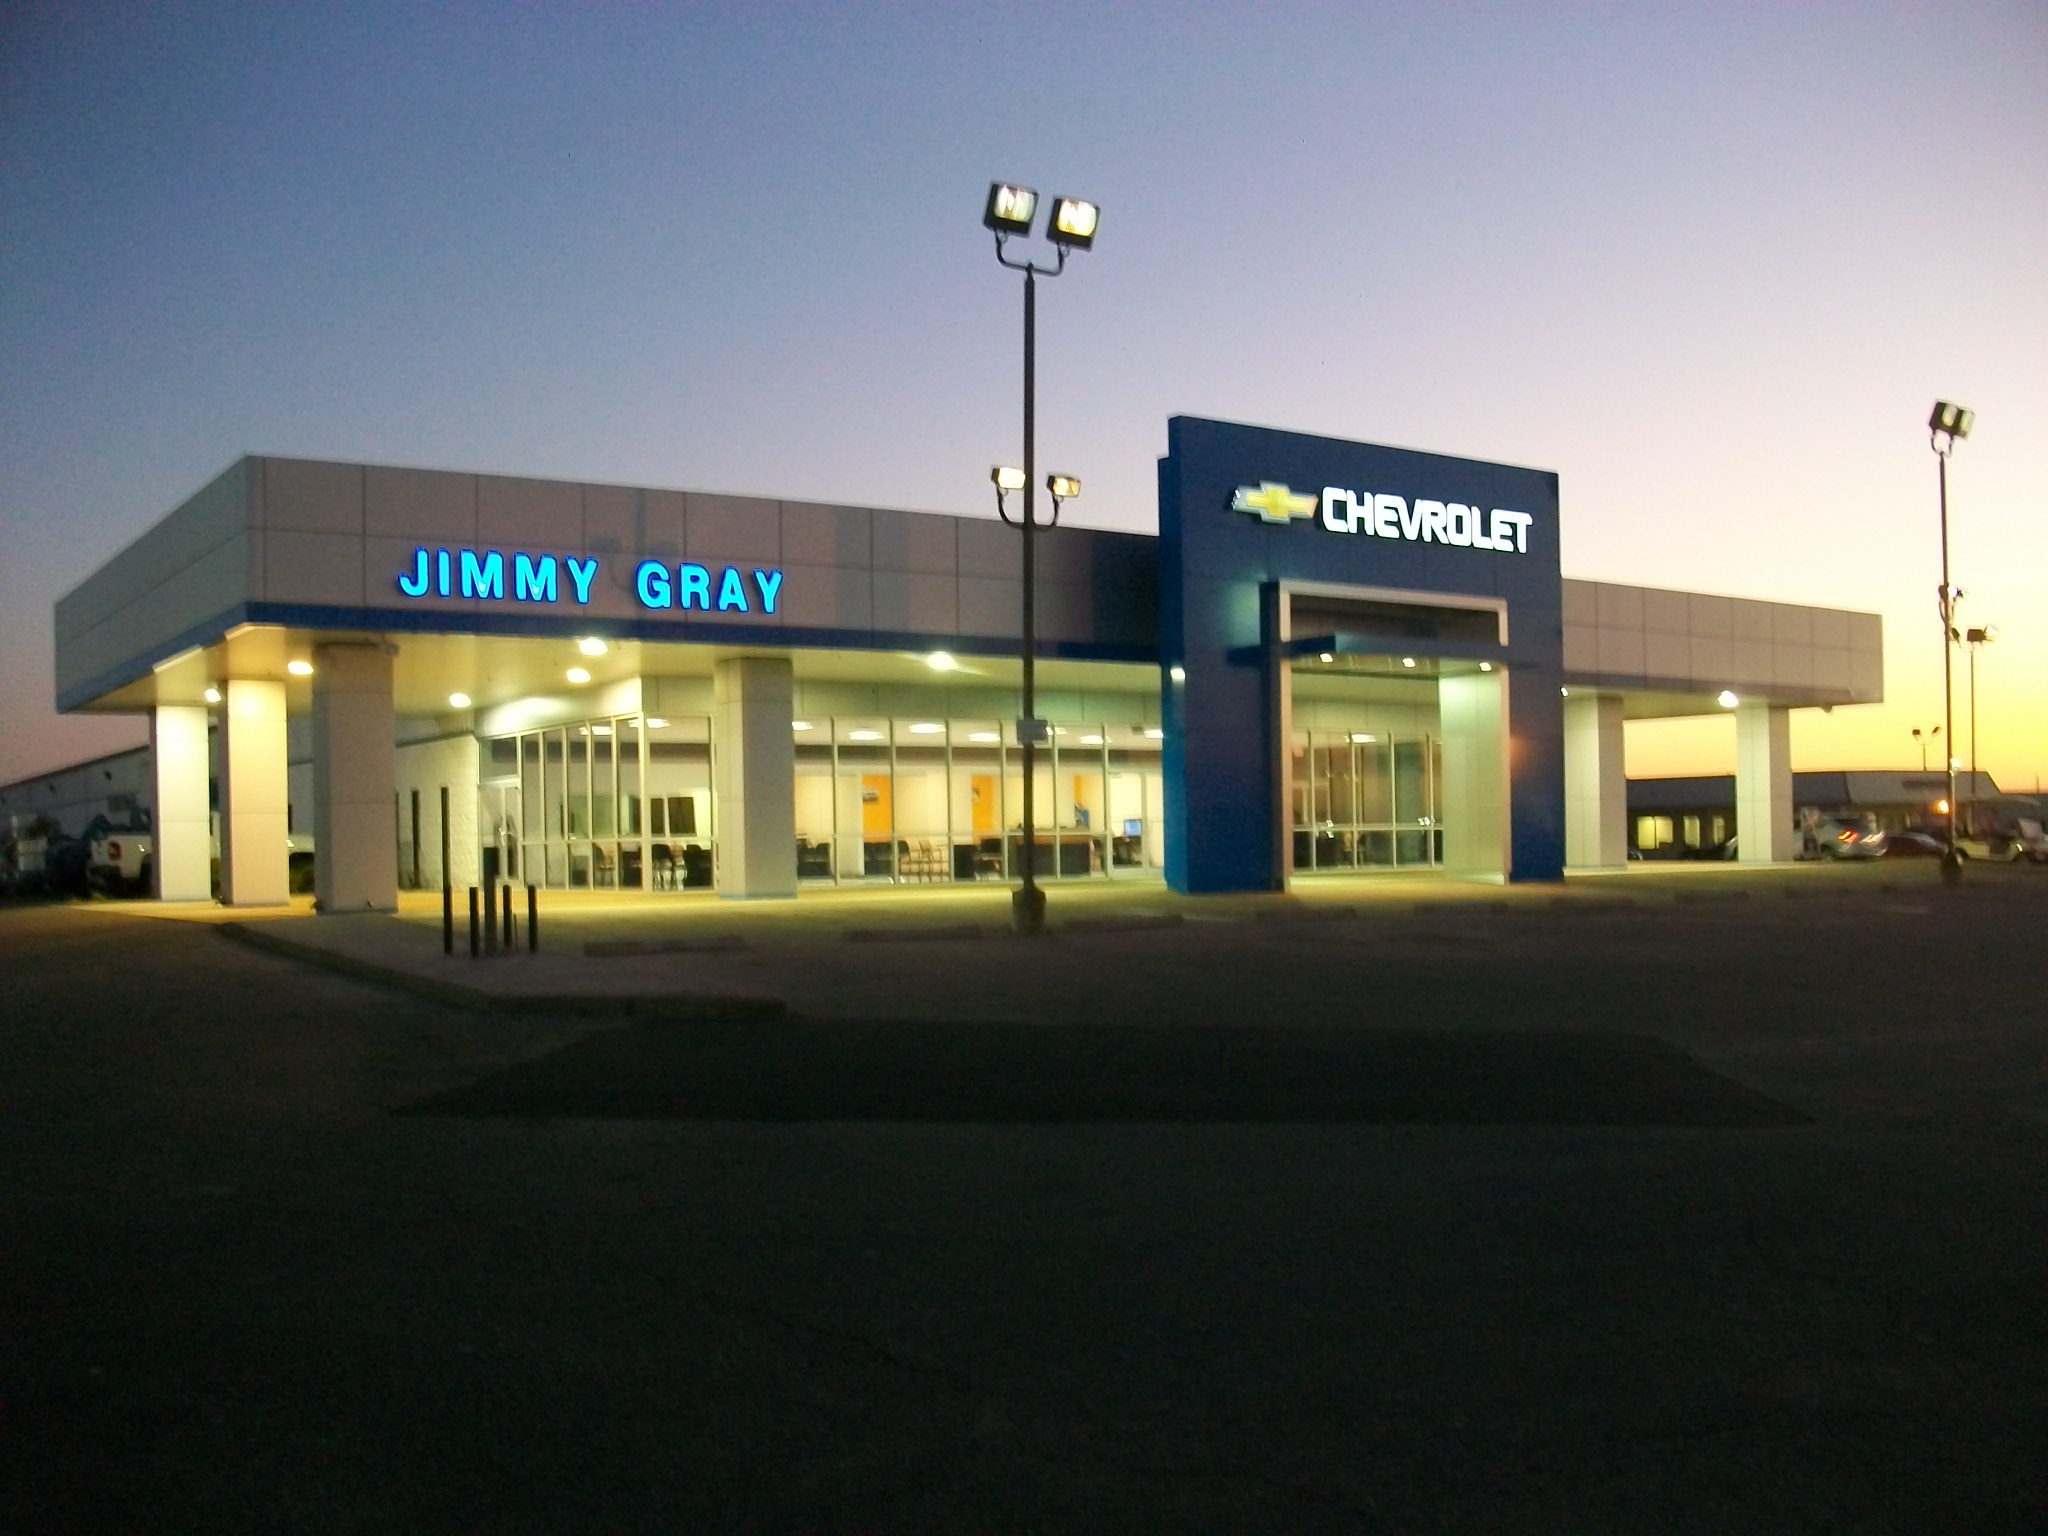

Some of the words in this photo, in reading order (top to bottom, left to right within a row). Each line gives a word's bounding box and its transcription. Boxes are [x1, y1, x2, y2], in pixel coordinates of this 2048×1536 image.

[1322, 486, 1533, 553] CHEVROLET
[398, 546, 598, 604] JIMMY
[635, 559, 783, 614] GRAY
